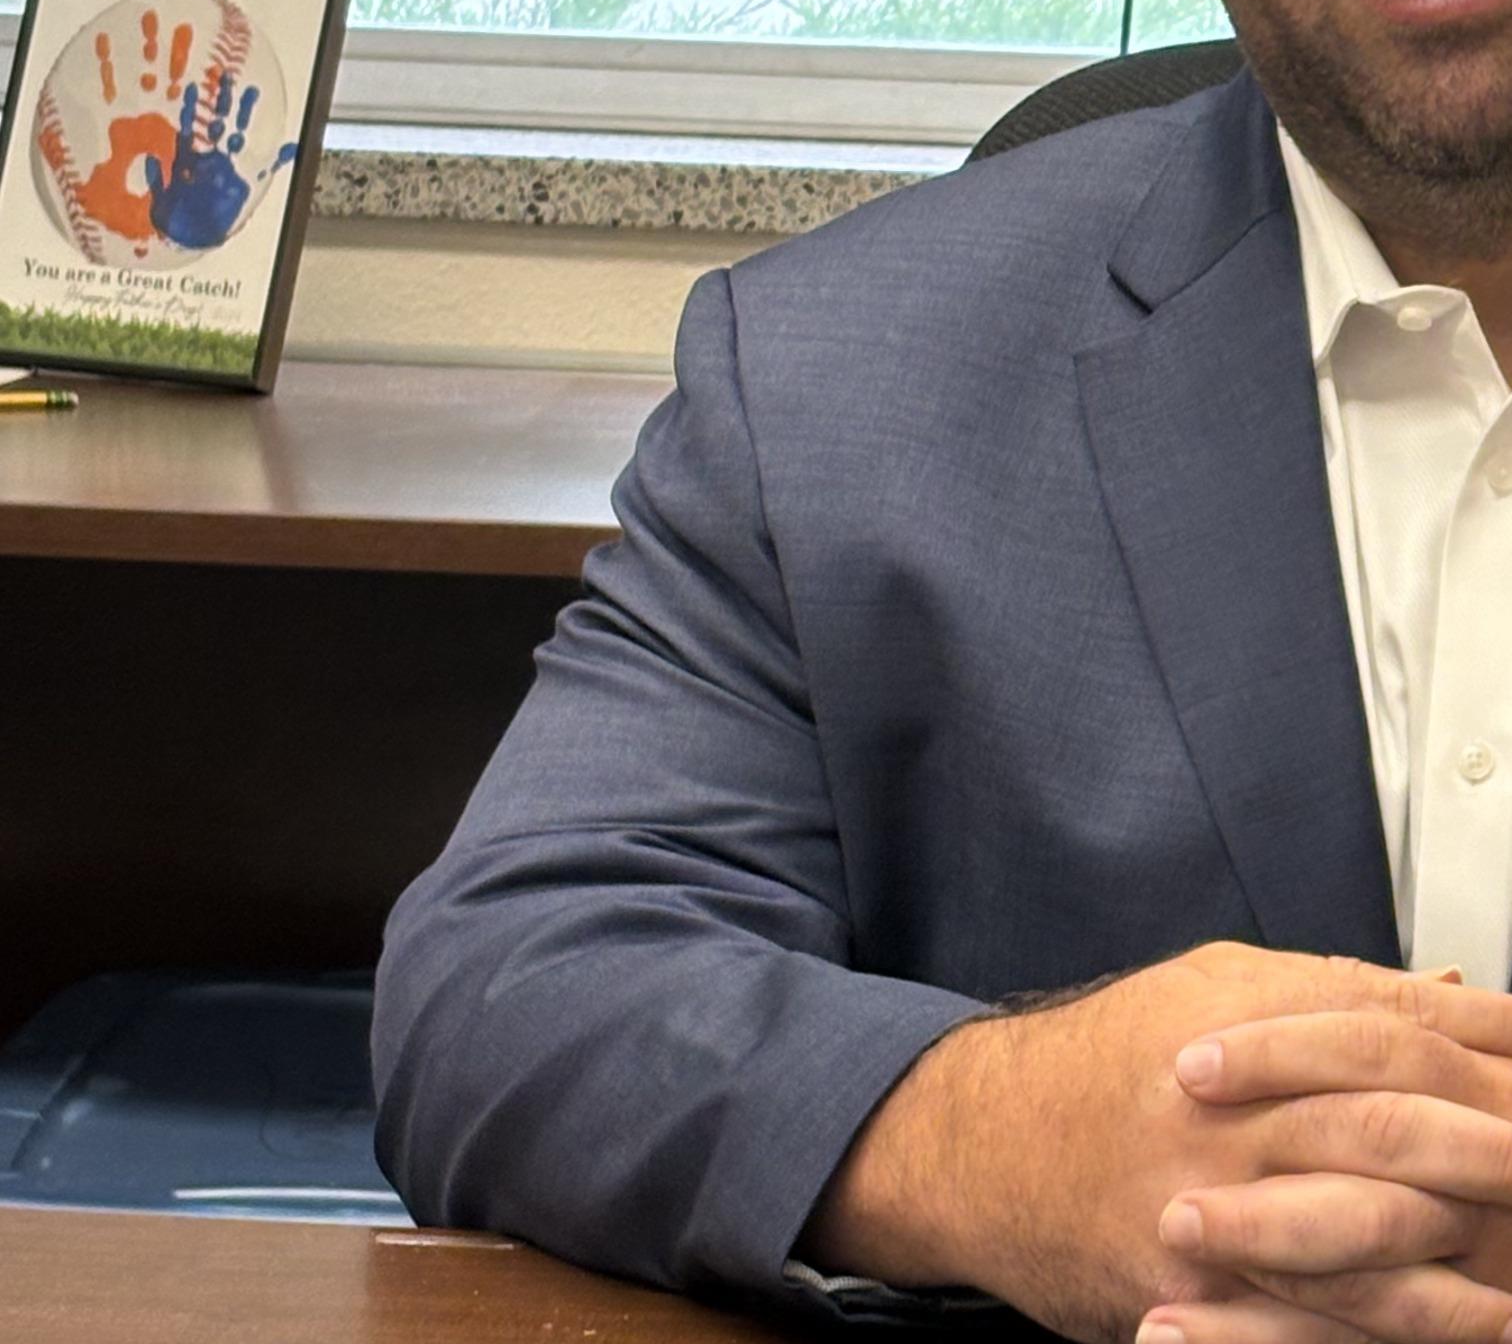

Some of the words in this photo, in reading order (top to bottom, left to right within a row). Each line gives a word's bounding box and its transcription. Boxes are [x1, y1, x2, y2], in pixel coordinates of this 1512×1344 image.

[24, 257, 60, 280] You
[65, 267, 97, 283] are
[100, 270, 111, 286] a
[117, 267, 173, 292] Great
[180, 275, 242, 299] Catch!
